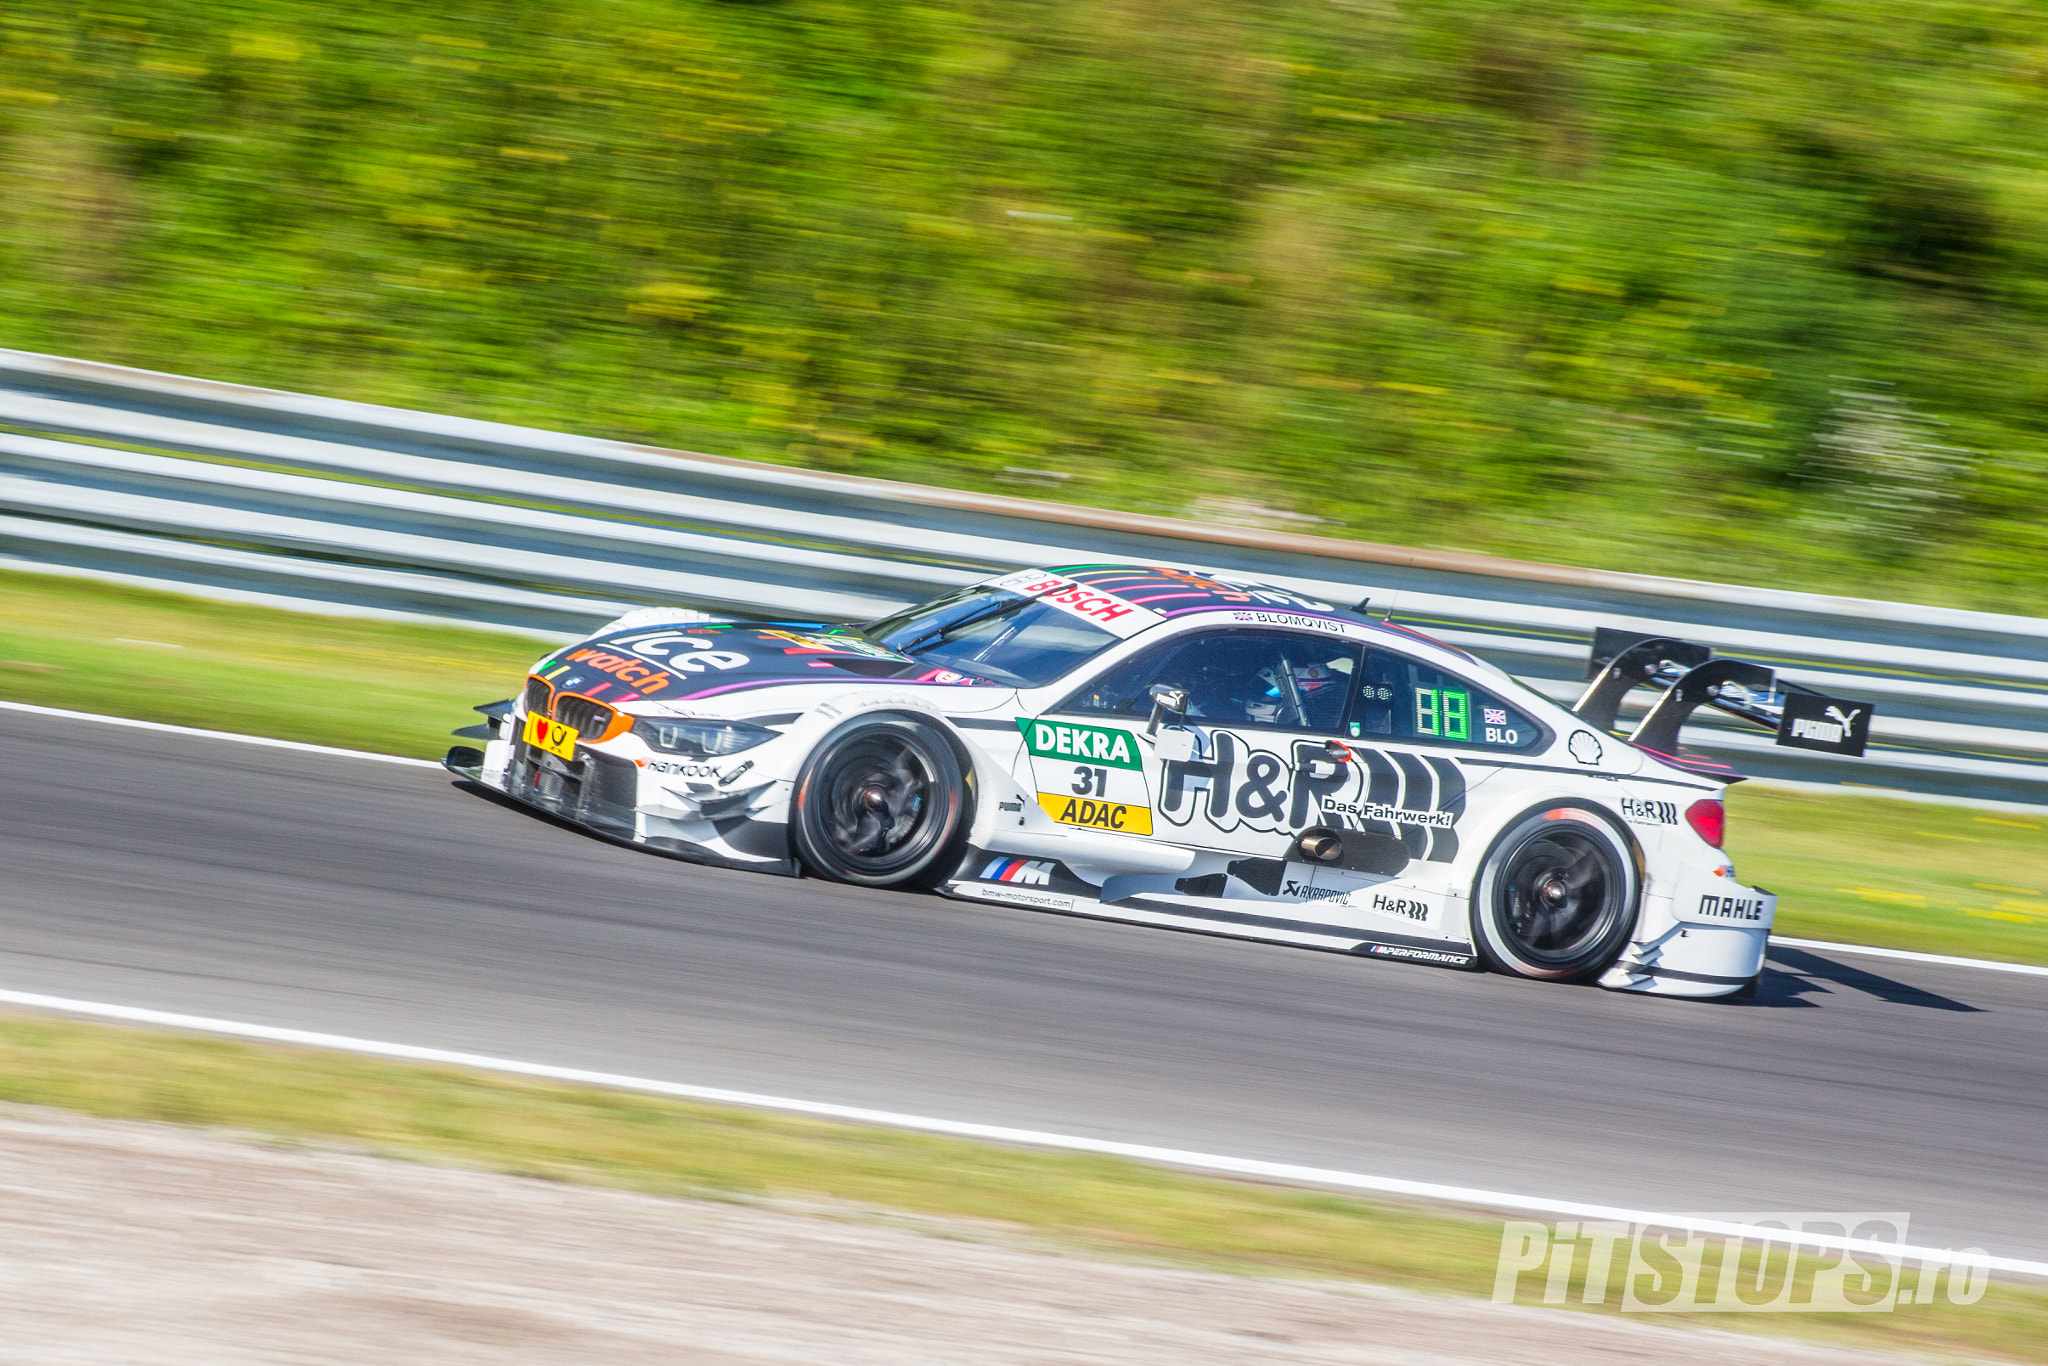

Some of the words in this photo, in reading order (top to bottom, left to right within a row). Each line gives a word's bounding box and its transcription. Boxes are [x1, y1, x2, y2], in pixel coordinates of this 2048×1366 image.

[1024, 580, 1134, 622] BOSCH
[1256, 613, 1346, 633] BLOMQVIST
[565, 648, 672, 694] watch
[1035, 724, 1131, 763] DEKRA
[1485, 727, 1518, 744] BLO
[1071, 766, 1107, 797] 31
[1162, 731, 1352, 830] H&R
[1060, 798, 1127, 828] ADAC
[1324, 799, 1358, 814] Das
[1364, 805, 1451, 827] Fahrwerk!
[1621, 797, 1656, 819] H&R
[981, 888, 1071, 908] bmw-motorsport.com
[1373, 894, 1406, 915] H&R
[1698, 894, 1764, 921] MAHLE
